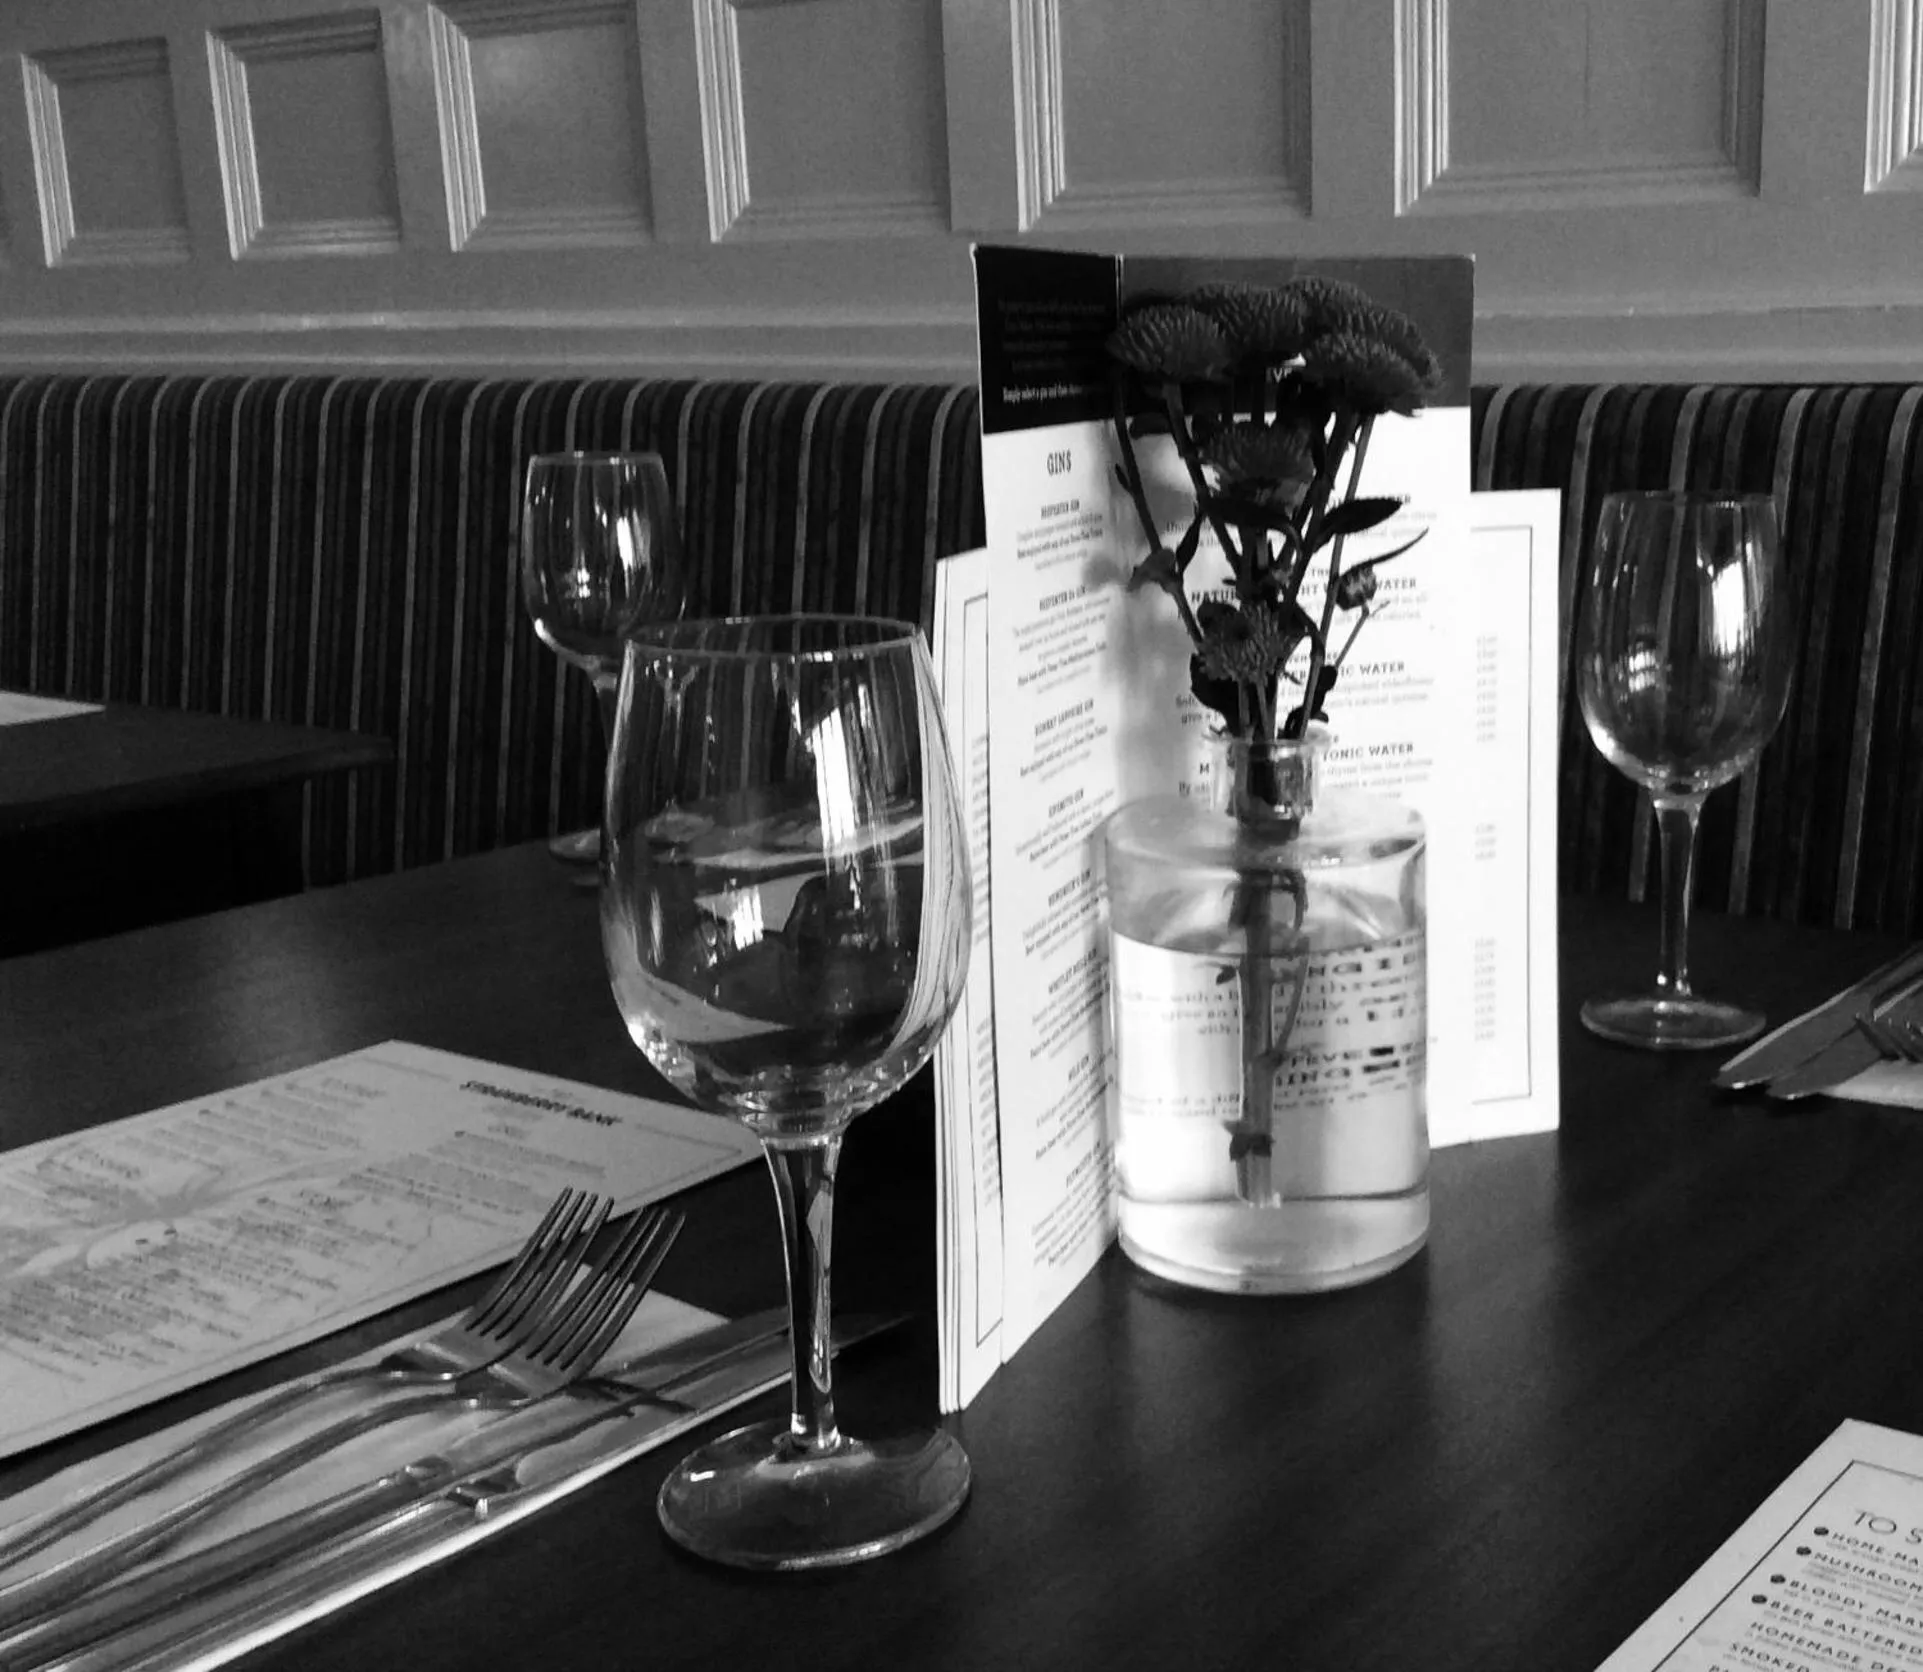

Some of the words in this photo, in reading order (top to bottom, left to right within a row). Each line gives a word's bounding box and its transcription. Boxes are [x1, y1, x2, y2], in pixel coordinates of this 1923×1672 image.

[1047, 449, 1071, 476] GINS
[1360, 661, 1405, 675] WATER
[1323, 747, 1364, 762] TONIC
[1369, 742, 1413, 757] WATER
[1854, 1509, 1897, 1535] TO
[1790, 1580, 1867, 1611] BLOODY
[1771, 1600, 1815, 1621] BEER
[1824, 1617, 1923, 1655] BATTERED
[1750, 1621, 1861, 1664] HOMEMADE
